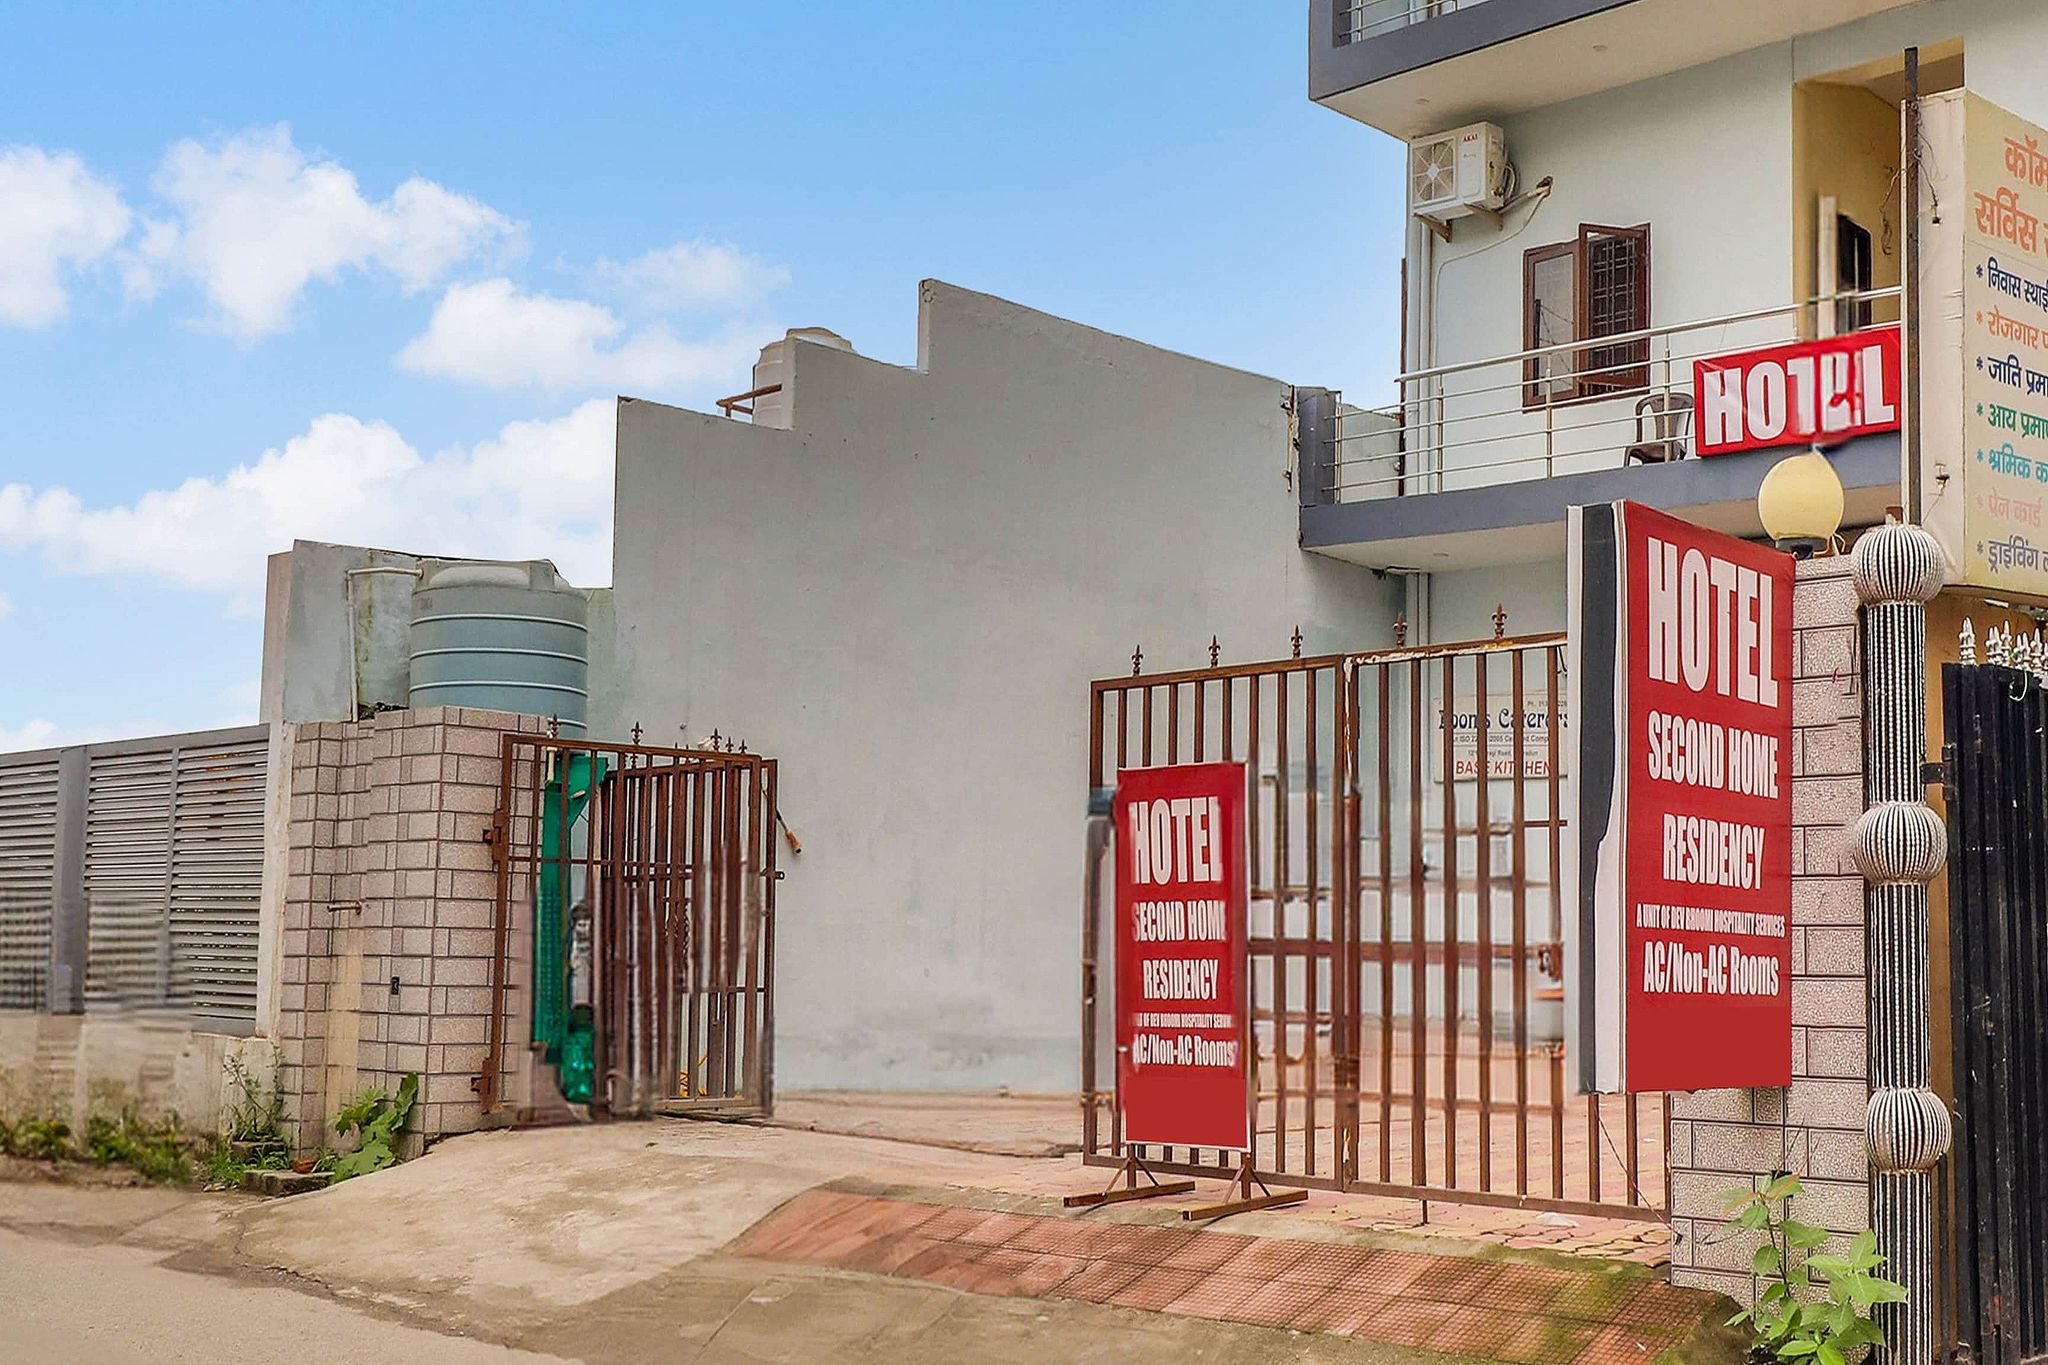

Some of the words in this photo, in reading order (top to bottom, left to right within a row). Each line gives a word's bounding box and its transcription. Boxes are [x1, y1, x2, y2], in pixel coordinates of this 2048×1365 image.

[1463, 133, 1478, 143] AKAI
[1974, 187, 2039, 253] सर्विस
[1988, 256, 2021, 298] निवास
[1988, 305, 2039, 349] रोजगार
[1987, 354, 2022, 388] जाति
[1988, 403, 2017, 431] आय
[1988, 443, 2032, 479] श्रमिक
[1647, 536, 1779, 708] HOTEL
[1494, 760, 1551, 775] KITHEN
[1647, 710, 1725, 788] SECOND
[1728, 727, 1779, 799] HOME
[1663, 813, 1765, 890] RESIDENCY
[1132, 900, 1185, 943] SECOND
[1636, 903, 1643, 927] A
[1643, 904, 1660, 928] UNIT
[1661, 905, 1670, 929] OF
[1671, 906, 1685, 930] DEV
[1714, 909, 1755, 935] HOSPITALITY
[1755, 913, 1785, 938] SERVICES
[1143, 959, 1219, 1000] RESIDENCY
[1643, 941, 1727, 993] AC/Non-AC
[1730, 946, 1779, 996] Rooms
[1133, 1033, 1192, 1066] AC/Non-AC
[1193, 1035, 1237, 1068] Rooms
